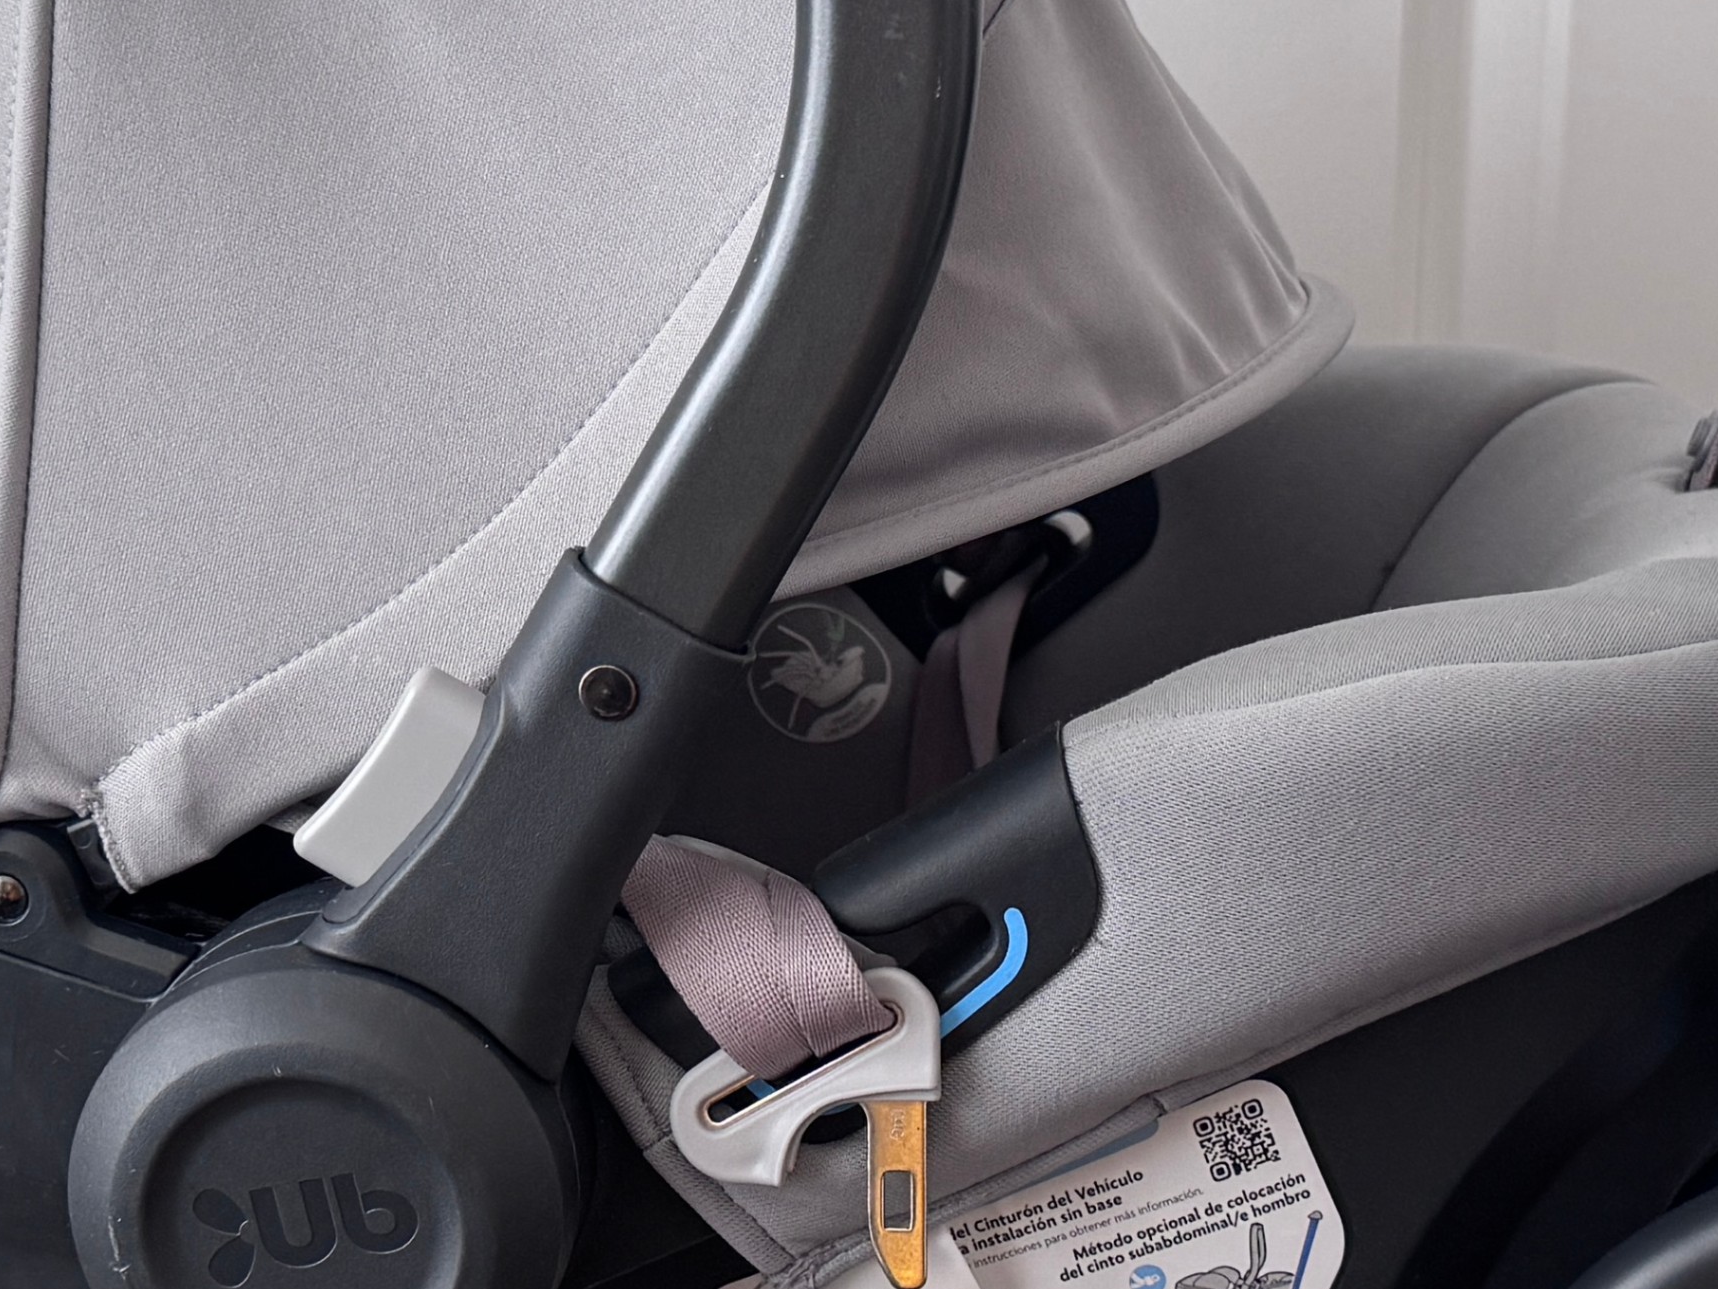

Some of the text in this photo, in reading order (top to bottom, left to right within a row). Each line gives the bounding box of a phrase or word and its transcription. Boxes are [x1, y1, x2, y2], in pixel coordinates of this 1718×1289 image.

[971, 1217, 1057, 1251] instalación
[1060, 1208, 1083, 1223] sin
[1084, 1196, 1122, 1215] base
[973, 1188, 1204, 1268] instrucciones para obtener más información.
[974, 1204, 1044, 1232] Cinturón
[1047, 1190, 1073, 1210] del
[1074, 1170, 1143, 1200] Vehículo
[1060, 1189, 1311, 1282] del cinto subabdominal/e hombro
[1073, 1174, 1306, 1261] Método opcional de colocación
